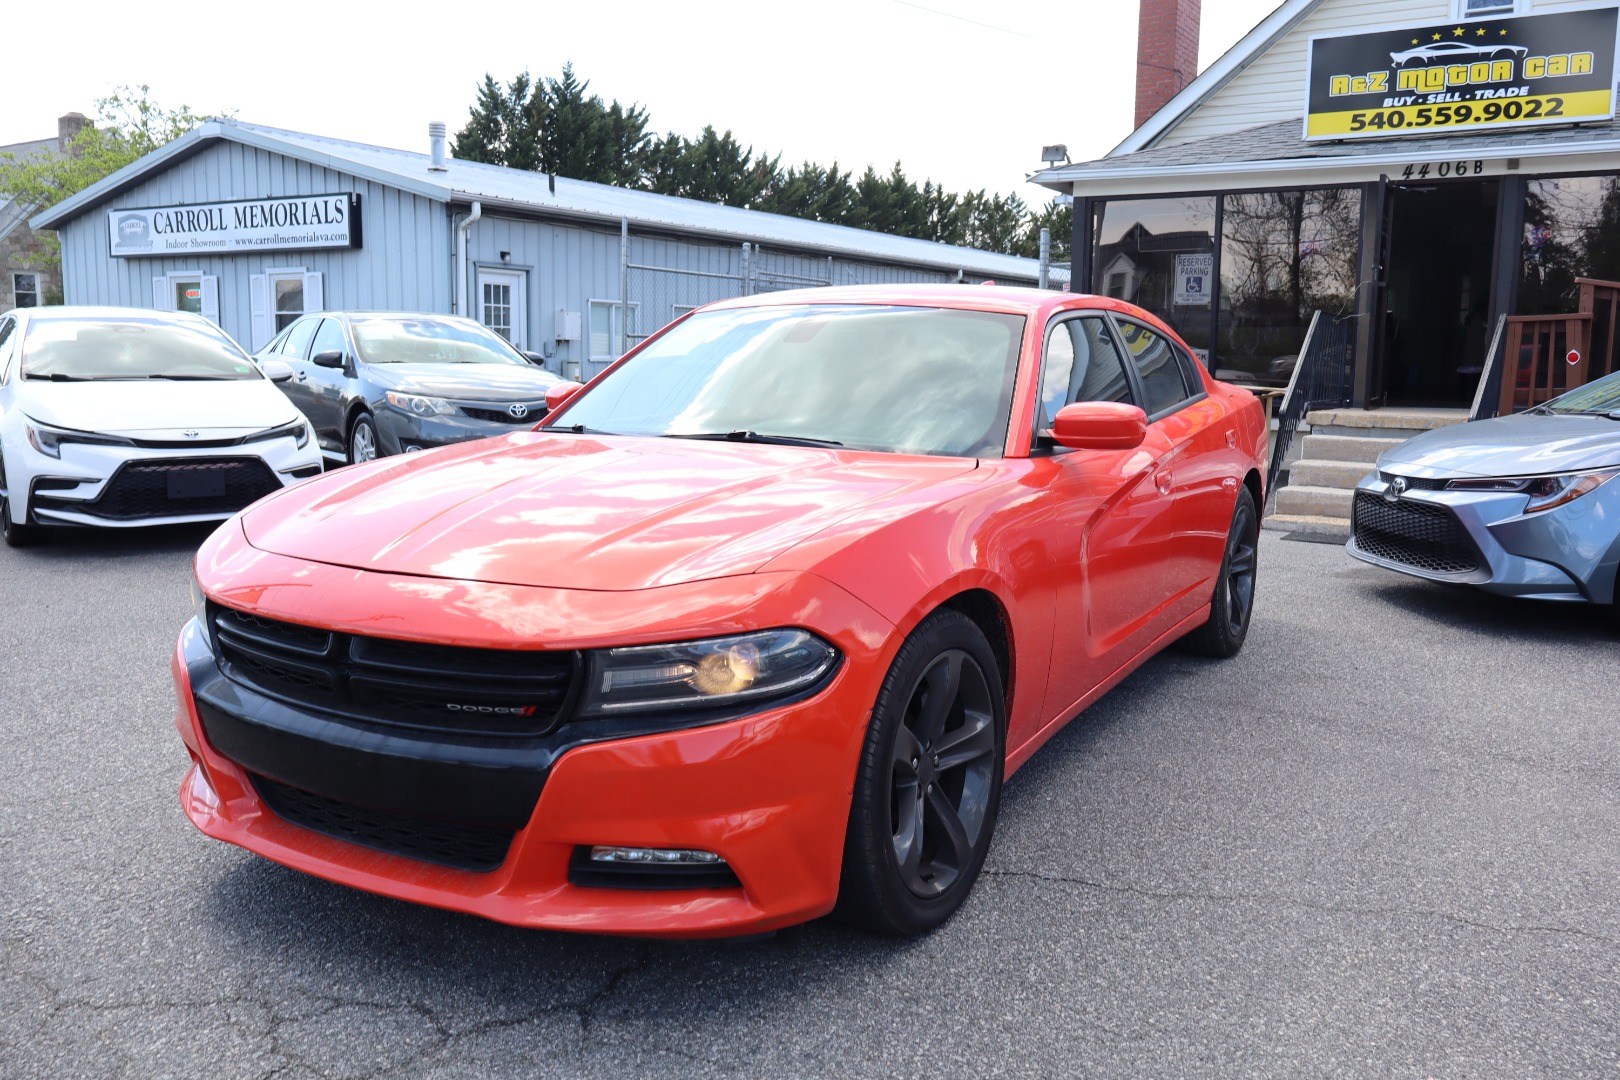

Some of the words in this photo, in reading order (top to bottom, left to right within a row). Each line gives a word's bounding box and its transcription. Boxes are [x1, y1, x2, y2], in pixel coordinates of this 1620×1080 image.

[1396, 59, 1514, 94] MOTOR
[1522, 51, 1594, 79] CAR
[1382, 95, 1416, 108] BUY
[1426, 92, 1462, 104] SELL
[1474, 86, 1530, 100] TRADE
[1350, 97, 1564, 131] 540.559.9022
[153, 208, 228, 235] CARROLL
[234, 199, 344, 229] MEMORIALS
[165, 238, 188, 249] Indoor
[190, 237, 227, 248] Showroom
[235, 232, 348, 246] www.carrollmemorialsva.com
[1178, 257, 1212, 267] RESERVED
[1181, 267, 1209, 276] PARKING
[446, 703, 526, 715] DODGE
